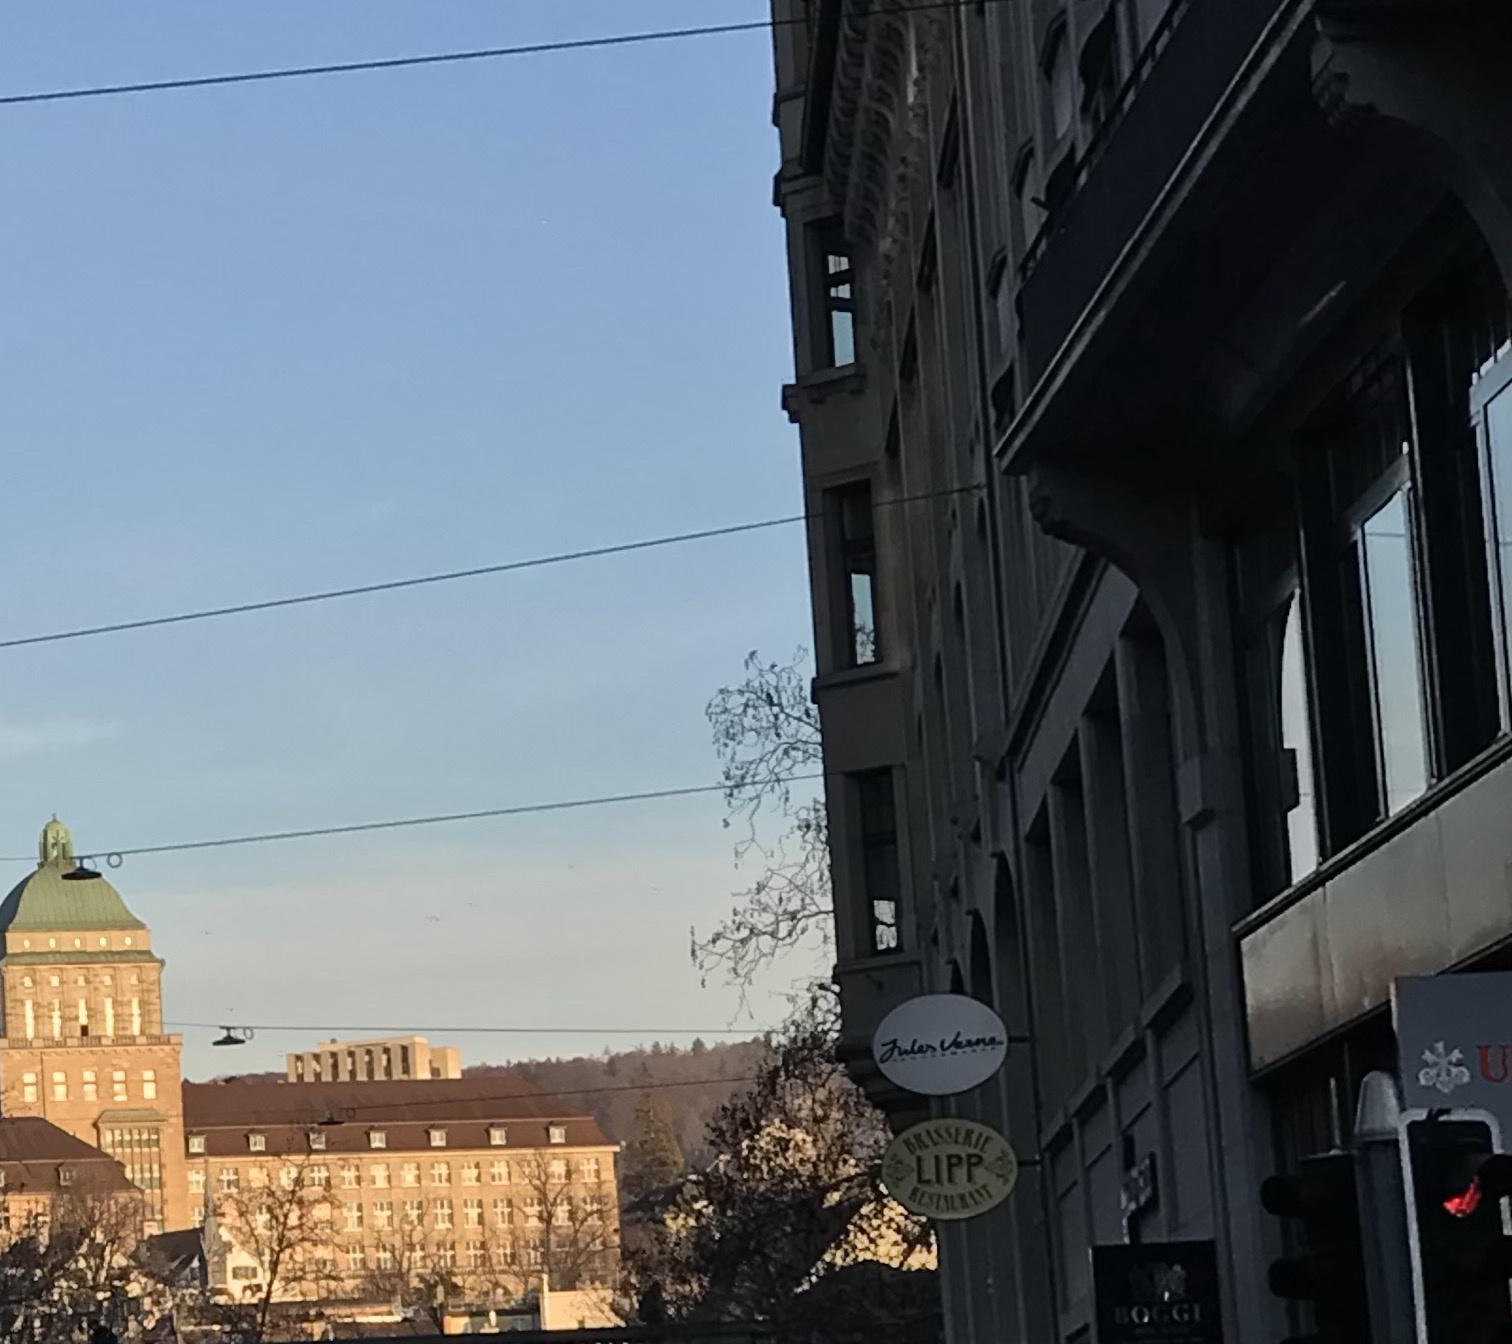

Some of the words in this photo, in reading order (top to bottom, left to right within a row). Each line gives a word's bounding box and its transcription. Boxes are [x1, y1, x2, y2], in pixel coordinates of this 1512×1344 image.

[879, 1039, 937, 1064] Jules
[940, 1031, 1004, 1052] Verne
[902, 1126, 993, 1155] BRASSERIE
[916, 1154, 983, 1184] LIPP
[908, 1184, 992, 1211] RESTAURANT
